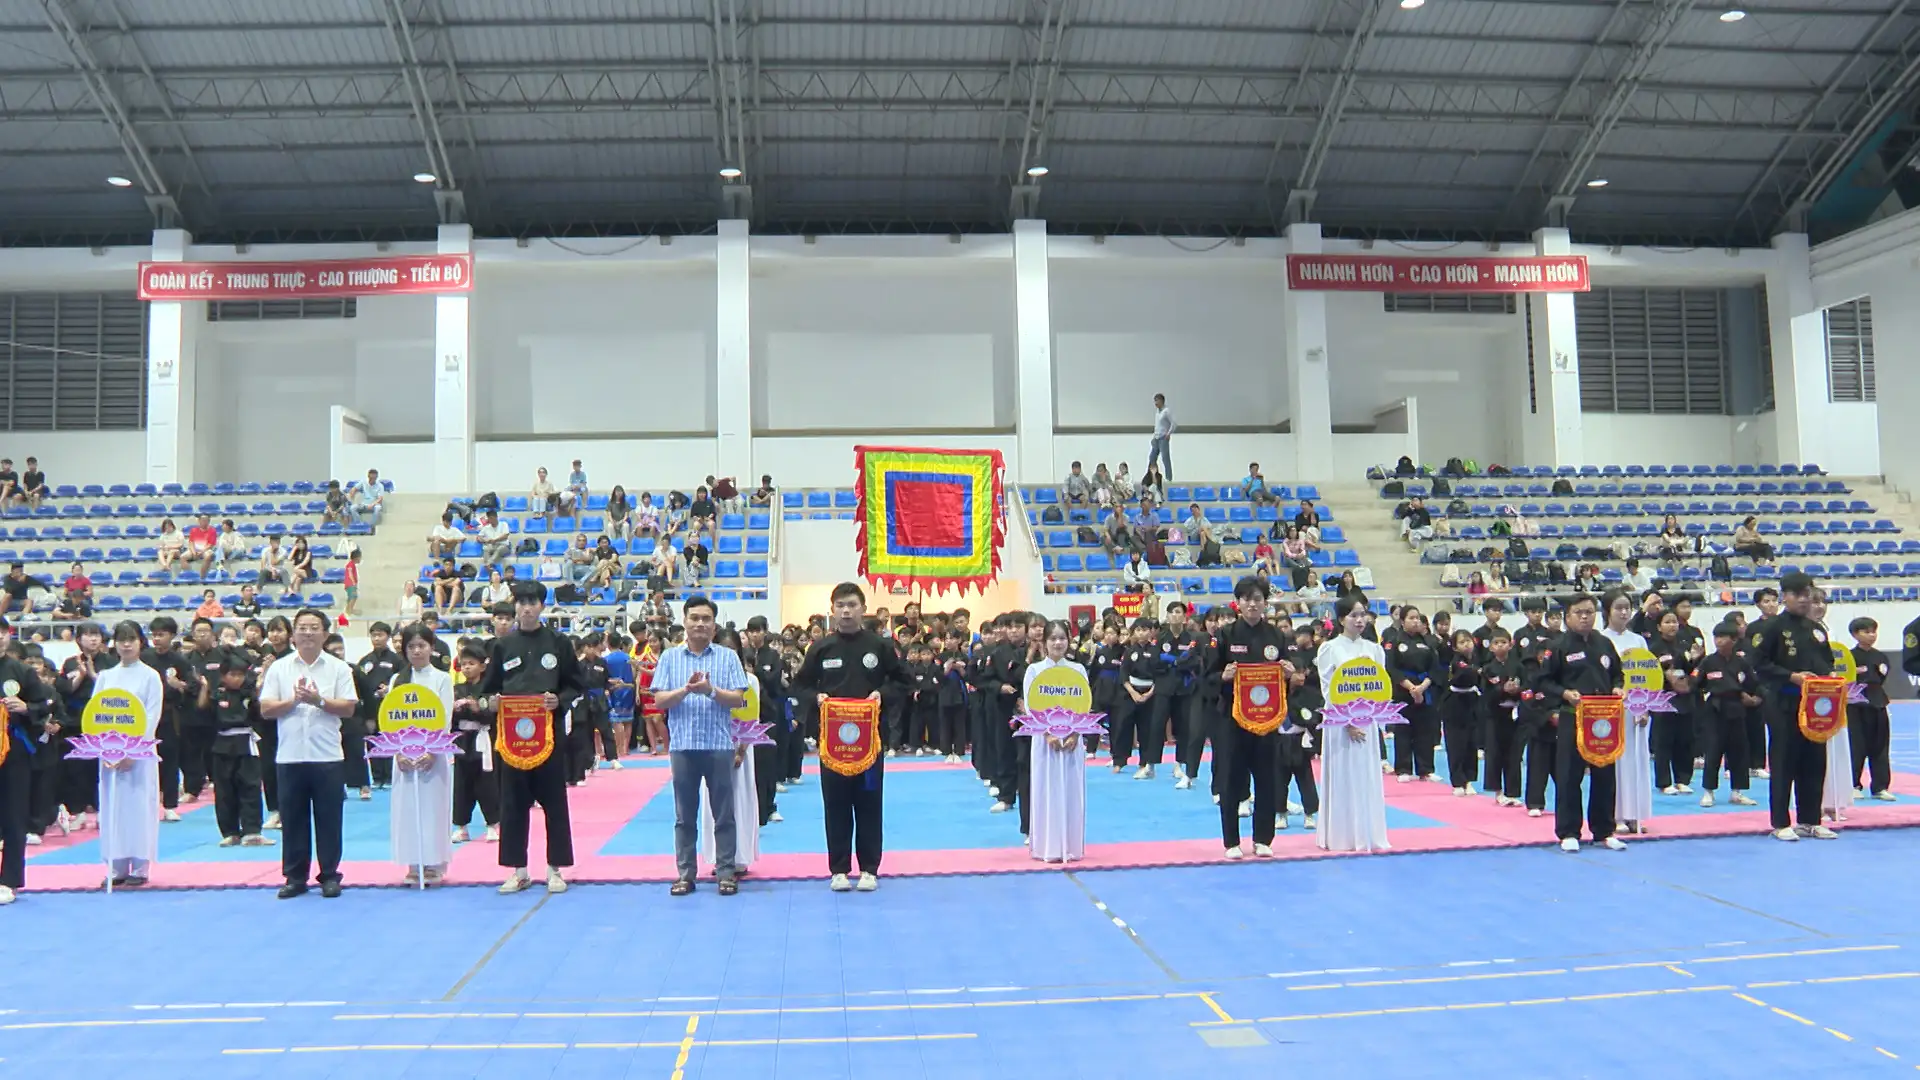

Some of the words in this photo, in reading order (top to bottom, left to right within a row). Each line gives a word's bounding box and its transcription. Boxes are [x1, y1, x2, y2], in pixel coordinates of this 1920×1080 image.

[150, 271, 186, 290] ĐOÀN
[190, 269, 215, 290] KẾT
[227, 273, 269, 289] TRUNG
[273, 271, 306, 292] THỰC
[318, 271, 344, 287] CAO
[348, 267, 398, 288] THƯỢNG
[410, 262, 441, 283] TIẾN
[444, 262, 462, 284] BỘ
[1300, 263, 1357, 281] NHANH
[1361, 263, 1394, 282] HƠN
[1410, 265, 1441, 283] CAO
[1445, 263, 1479, 283] HƠN
[1494, 265, 1542, 287] MẠNH
[1546, 262, 1579, 282] HƠN
[411, 709, 436, 720] KHAI
